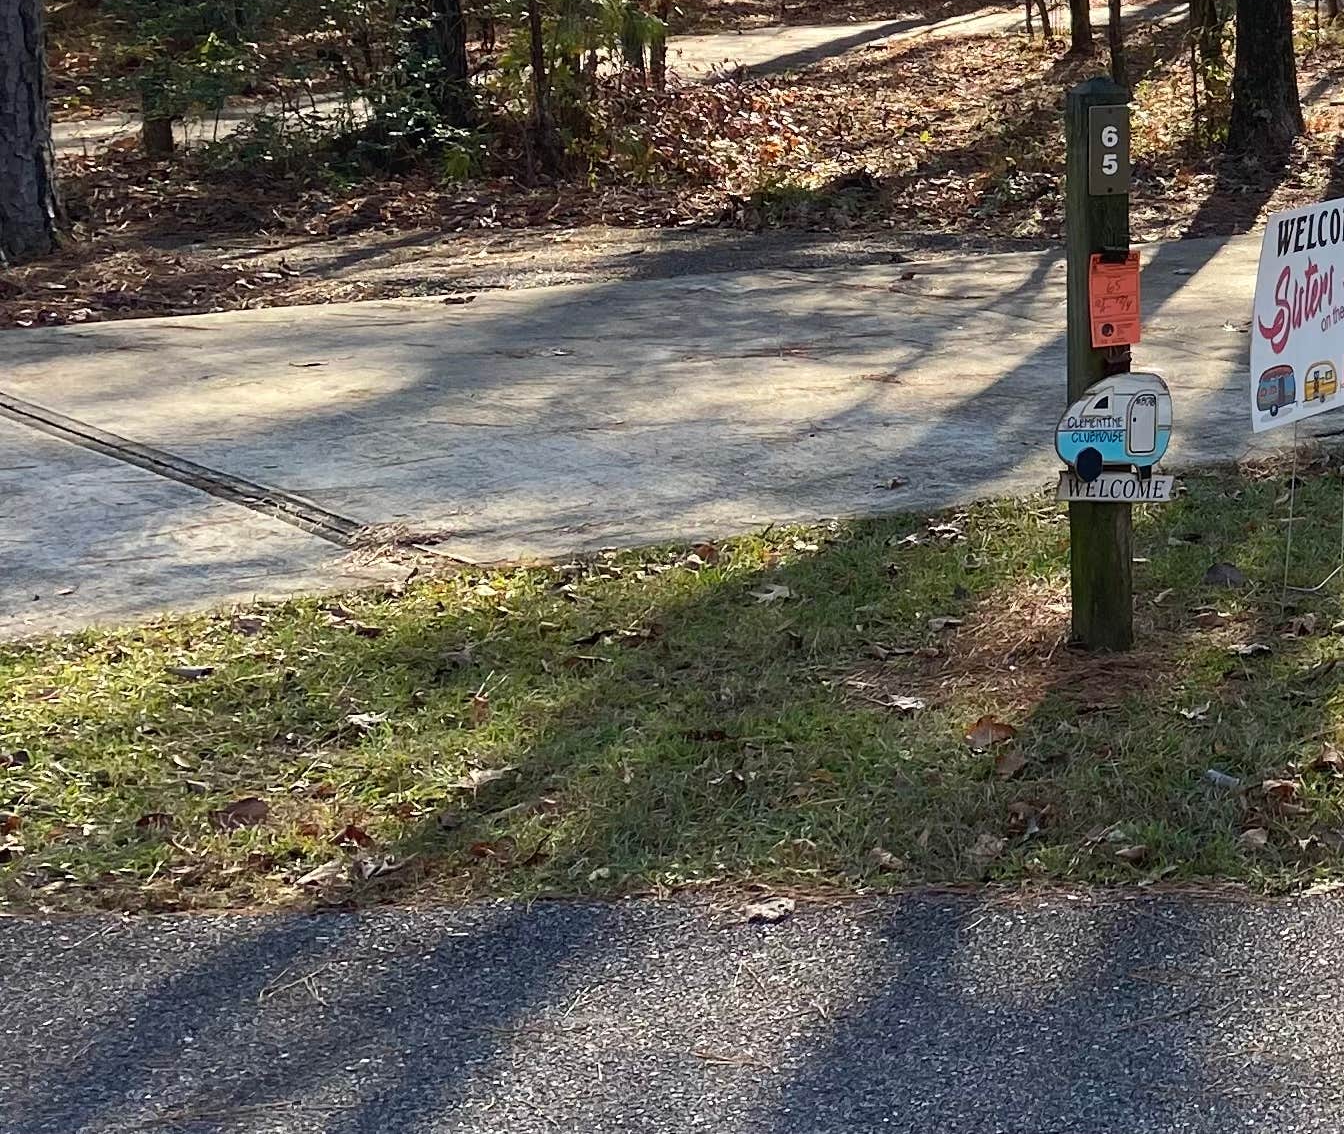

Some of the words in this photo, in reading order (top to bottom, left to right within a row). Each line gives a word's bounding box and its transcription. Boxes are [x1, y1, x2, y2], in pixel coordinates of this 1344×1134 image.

[1258, 257, 1335, 354] Sisters
[1320, 315, 1332, 332] on
[1067, 416, 1123, 428] CLEMENTINE
[1071, 431, 1124, 443] CLUBHOUSE
[1067, 478, 1167, 499] WELCOME
